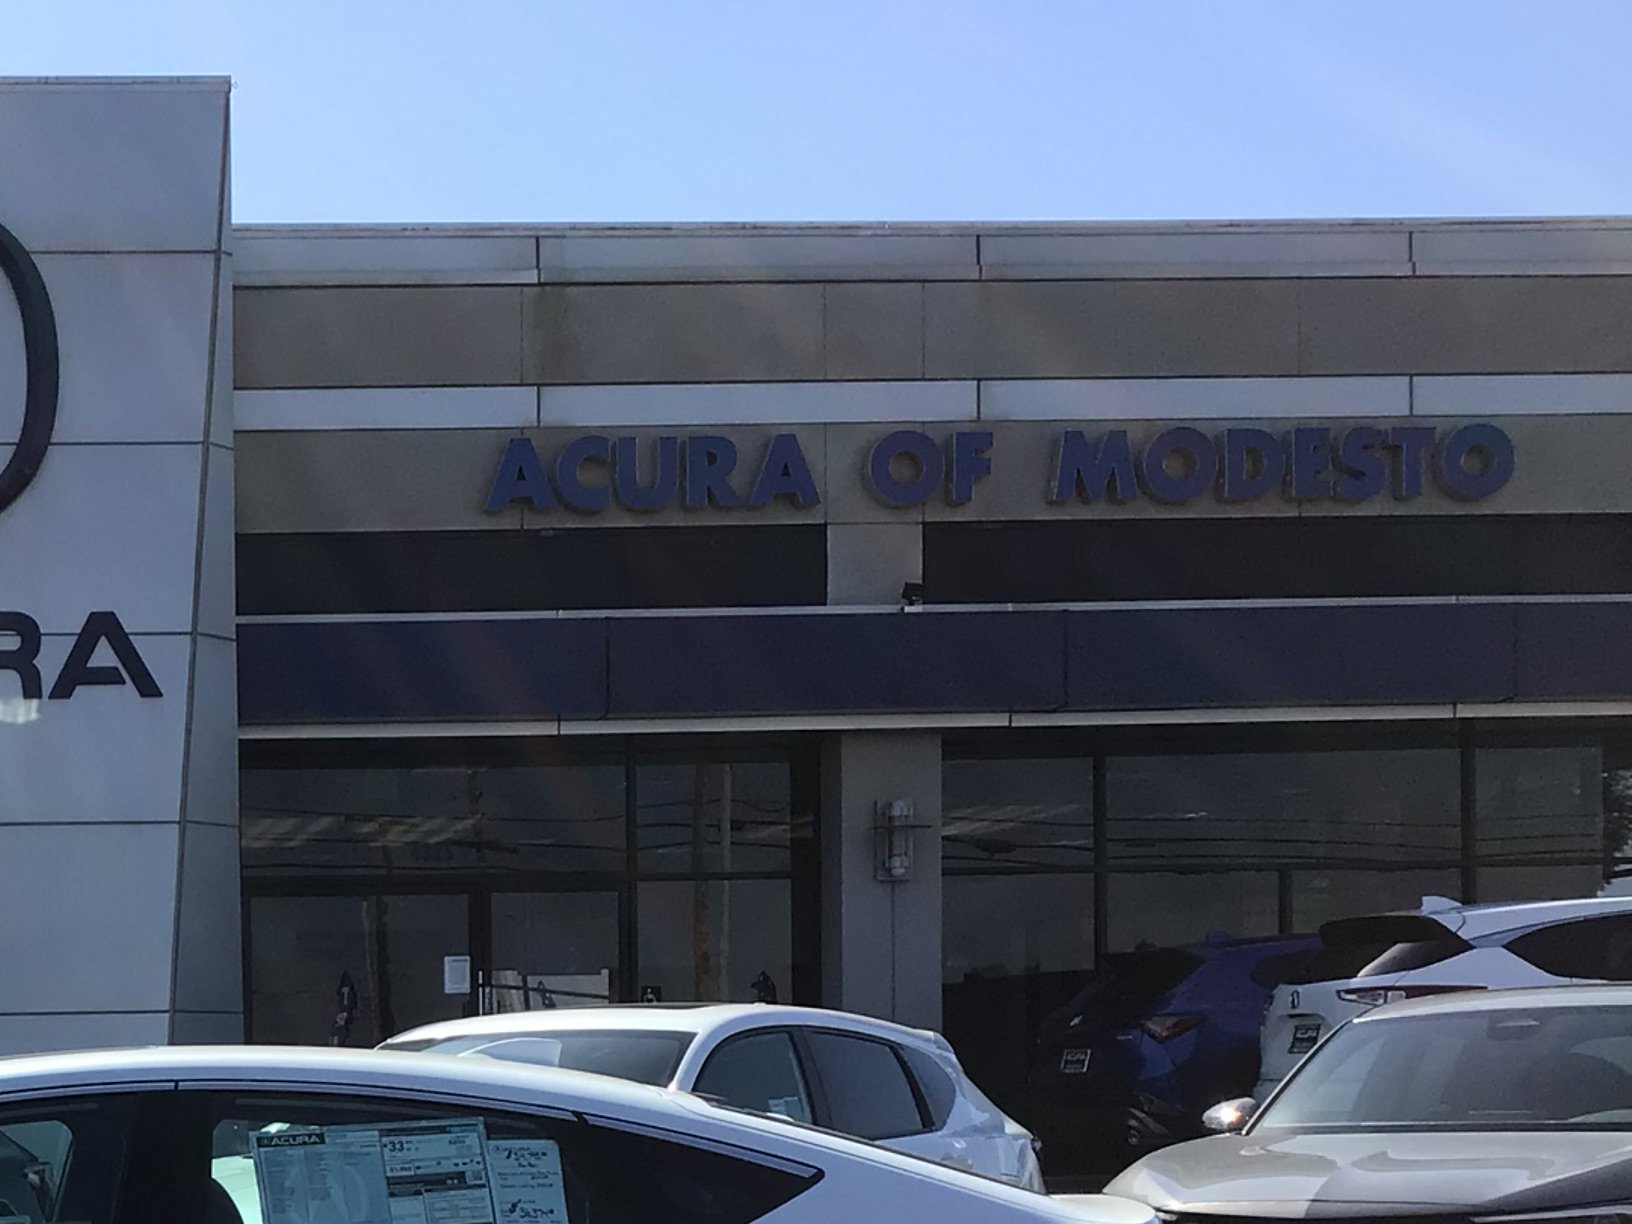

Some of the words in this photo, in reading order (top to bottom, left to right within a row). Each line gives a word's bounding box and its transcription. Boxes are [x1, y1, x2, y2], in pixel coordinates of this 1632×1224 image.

[485, 432, 821, 511] ACURA
[868, 429, 994, 507] OF
[1055, 423, 1516, 502] MODESTO
[271, 1135, 322, 1146] ACURA
